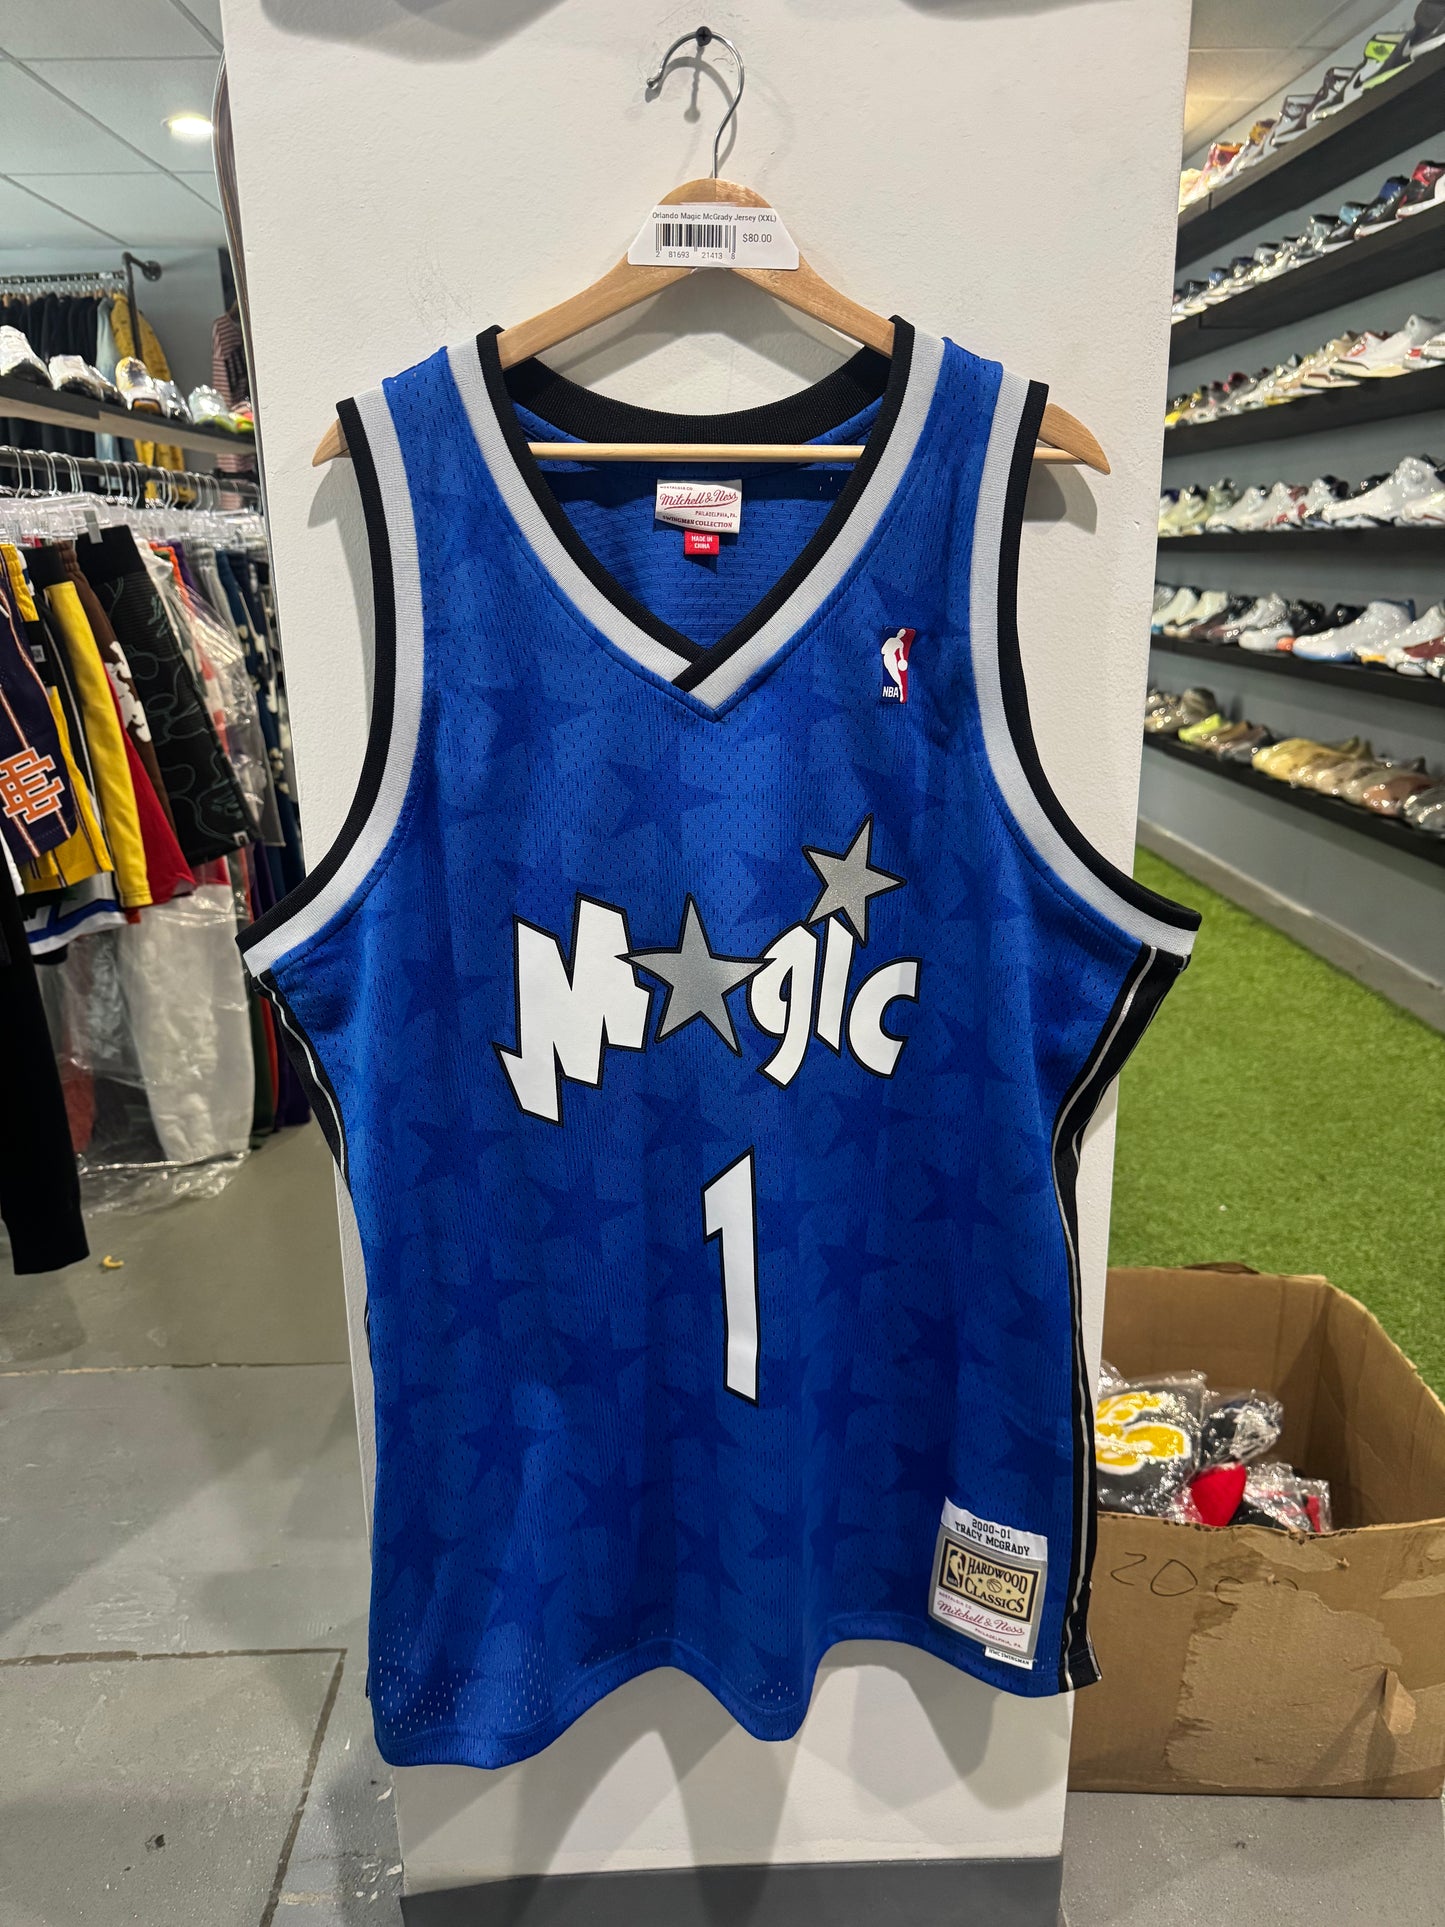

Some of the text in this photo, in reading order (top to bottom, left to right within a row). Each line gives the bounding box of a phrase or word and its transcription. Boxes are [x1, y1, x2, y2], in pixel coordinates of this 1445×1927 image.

[680, 212, 701, 221] Magic
[703, 213, 733, 222] McGrady
[734, 214, 756, 223] Jersey
[758, 215, 777, 223] (XXL)
[742, 233, 772, 243] $80.00
[701, 252, 723, 260] 21413
[660, 489, 739, 506] Mitchell & Ness
[663, 515, 733, 528] SWINGMAN COLLECTION
[882, 686, 899, 698] NBA
[701, 1144, 761, 1408] 1
[955, 1521, 1030, 1556] TRACY MCGRADY
[972, 1518, 1011, 1540] 2000-01
[967, 1556, 1028, 1595] HARDWOOD
[965, 1576, 1025, 1613] CLASSICS
[937, 1600, 982, 1624] Mitchell
[983, 1617, 994, 1628] &
[994, 1618, 1025, 1634] Ness
